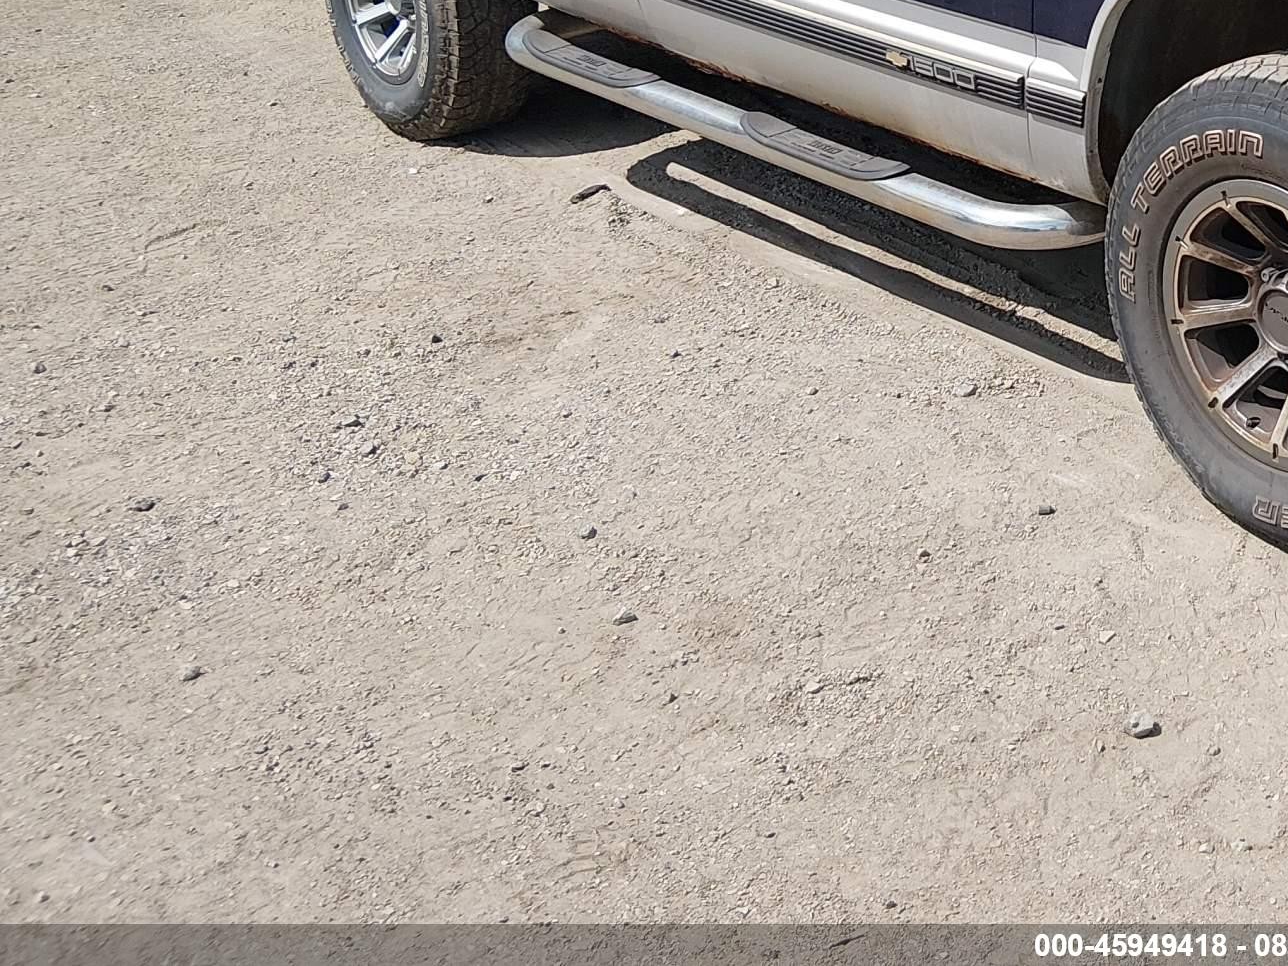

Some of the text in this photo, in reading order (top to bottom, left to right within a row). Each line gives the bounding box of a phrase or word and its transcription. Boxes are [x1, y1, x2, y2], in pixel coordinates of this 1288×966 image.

[905, 54, 976, 91] 1500
[1117, 128, 1264, 304] ALL TERRAIN
